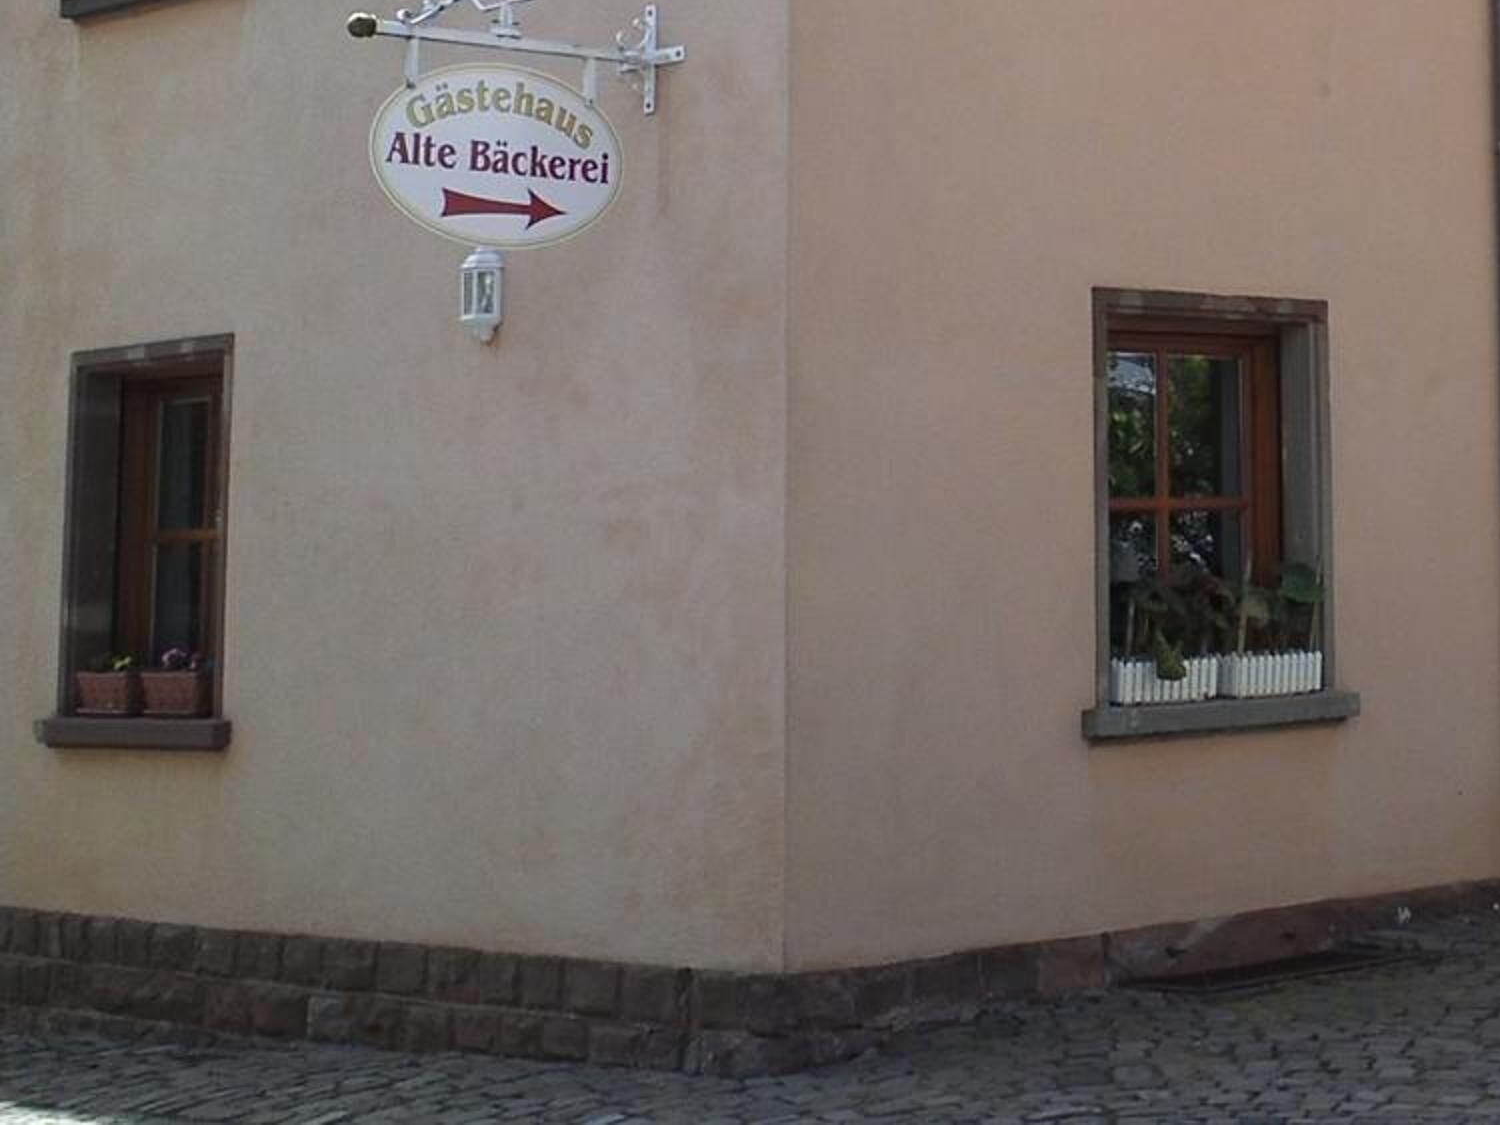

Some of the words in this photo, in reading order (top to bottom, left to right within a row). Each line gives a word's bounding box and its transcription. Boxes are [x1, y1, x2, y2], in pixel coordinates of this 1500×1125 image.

[405, 79, 594, 150] Gästehaus
[386, 131, 457, 170] Alte
[469, 139, 609, 184] Bäckerei
